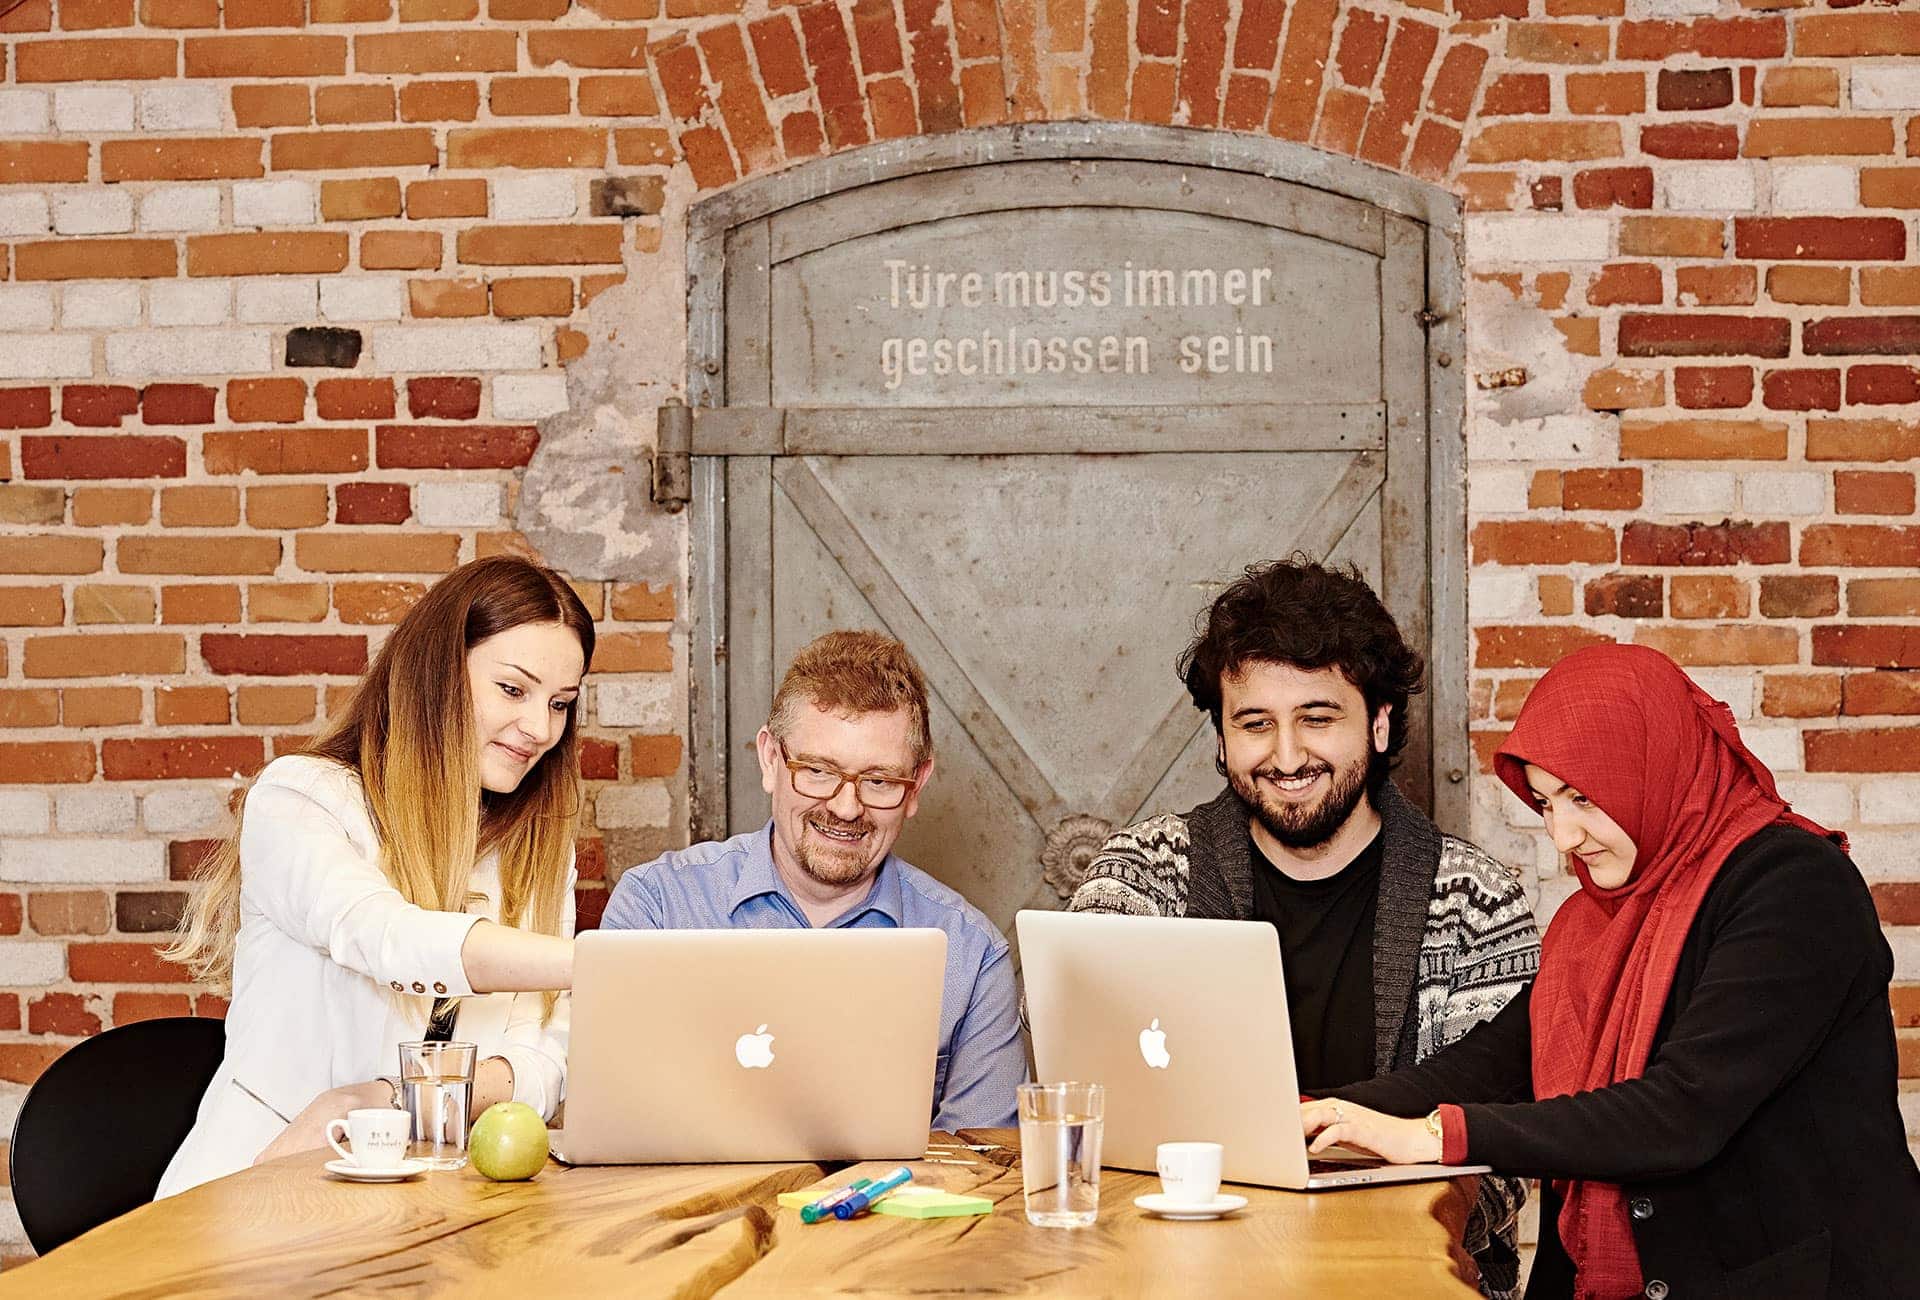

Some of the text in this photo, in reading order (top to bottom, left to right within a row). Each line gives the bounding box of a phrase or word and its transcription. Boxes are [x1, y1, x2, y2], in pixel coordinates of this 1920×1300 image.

[883, 260, 1272, 309] Türe muss immer
[881, 327, 1273, 390] geschlossen sein
